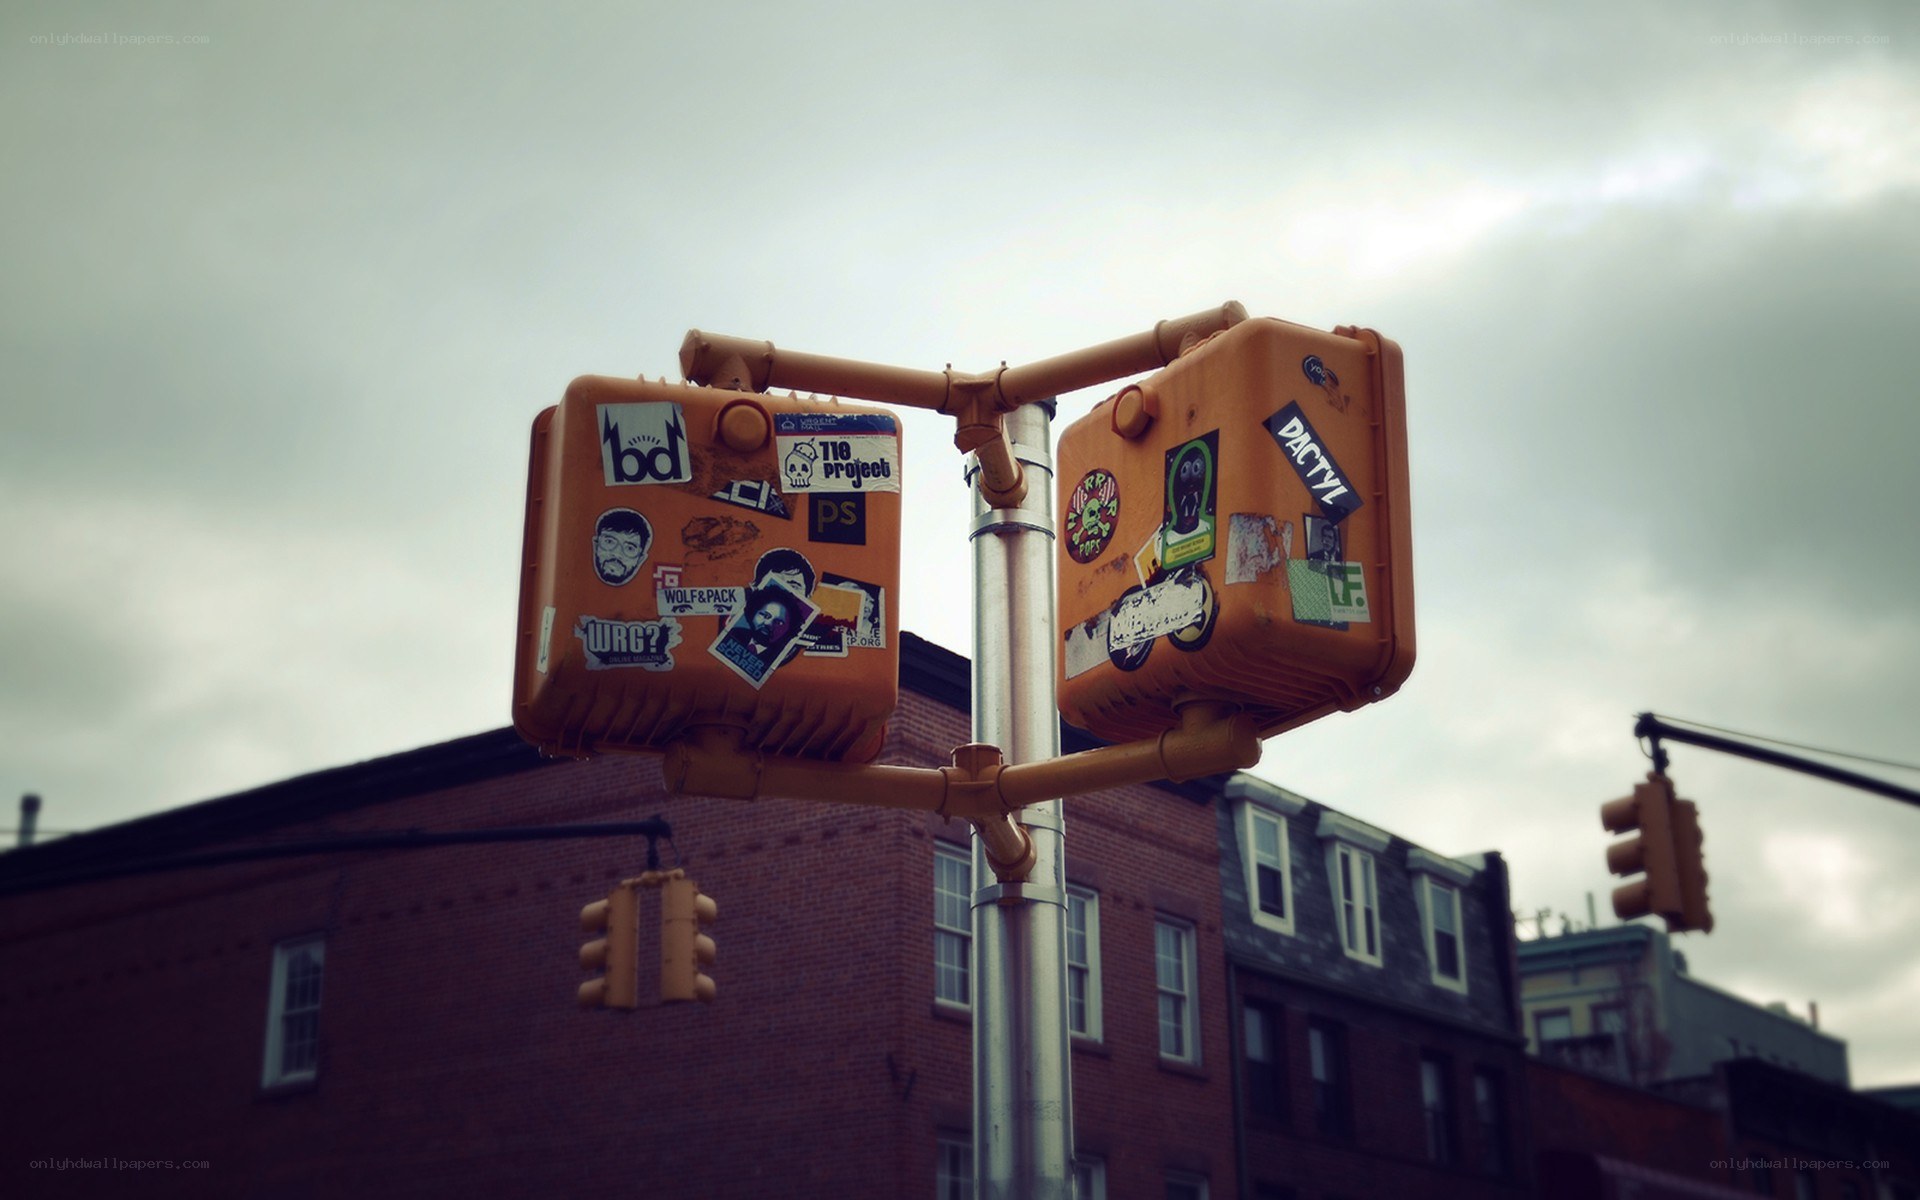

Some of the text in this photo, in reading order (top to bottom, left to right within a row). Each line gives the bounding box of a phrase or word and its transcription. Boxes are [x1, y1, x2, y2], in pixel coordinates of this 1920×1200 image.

[800, 417, 837, 425] URGENT
[823, 458, 891, 489] project
[1278, 416, 1348, 505] DACTYL
[664, 588, 737, 604] WOLF&PACK
[587, 622, 660, 653] WRG?
[717, 643, 763, 680] SCARED
[727, 638, 765, 669] NEVER
